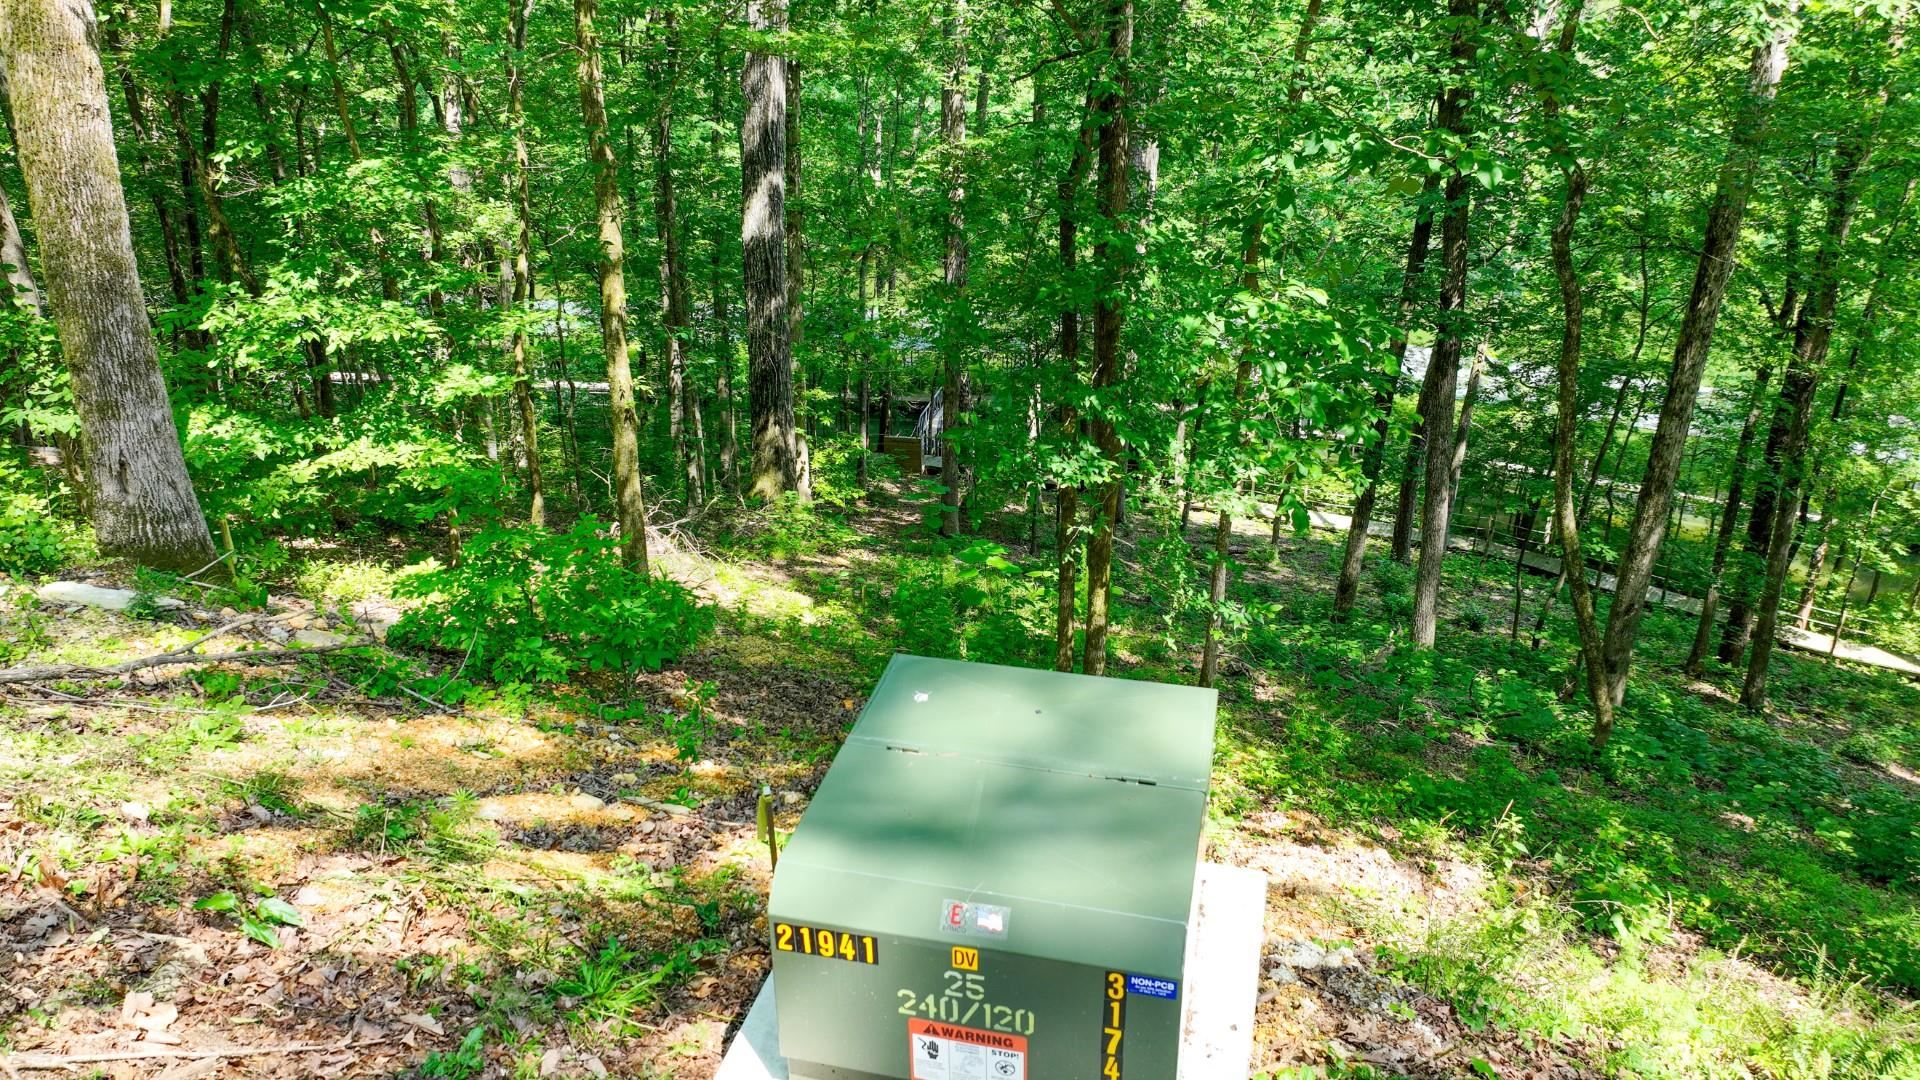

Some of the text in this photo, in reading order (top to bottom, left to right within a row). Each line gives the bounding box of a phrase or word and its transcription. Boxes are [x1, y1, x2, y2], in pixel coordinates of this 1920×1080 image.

[776, 923, 874, 964] 21941
[954, 952, 976, 968] DV
[944, 970, 985, 1000] 25
[1131, 976, 1175, 991] NON-PCB
[897, 989, 1035, 1035] 240/120
[941, 1027, 1013, 1048] WARNING
[991, 1049, 1019, 1059] STOP!
